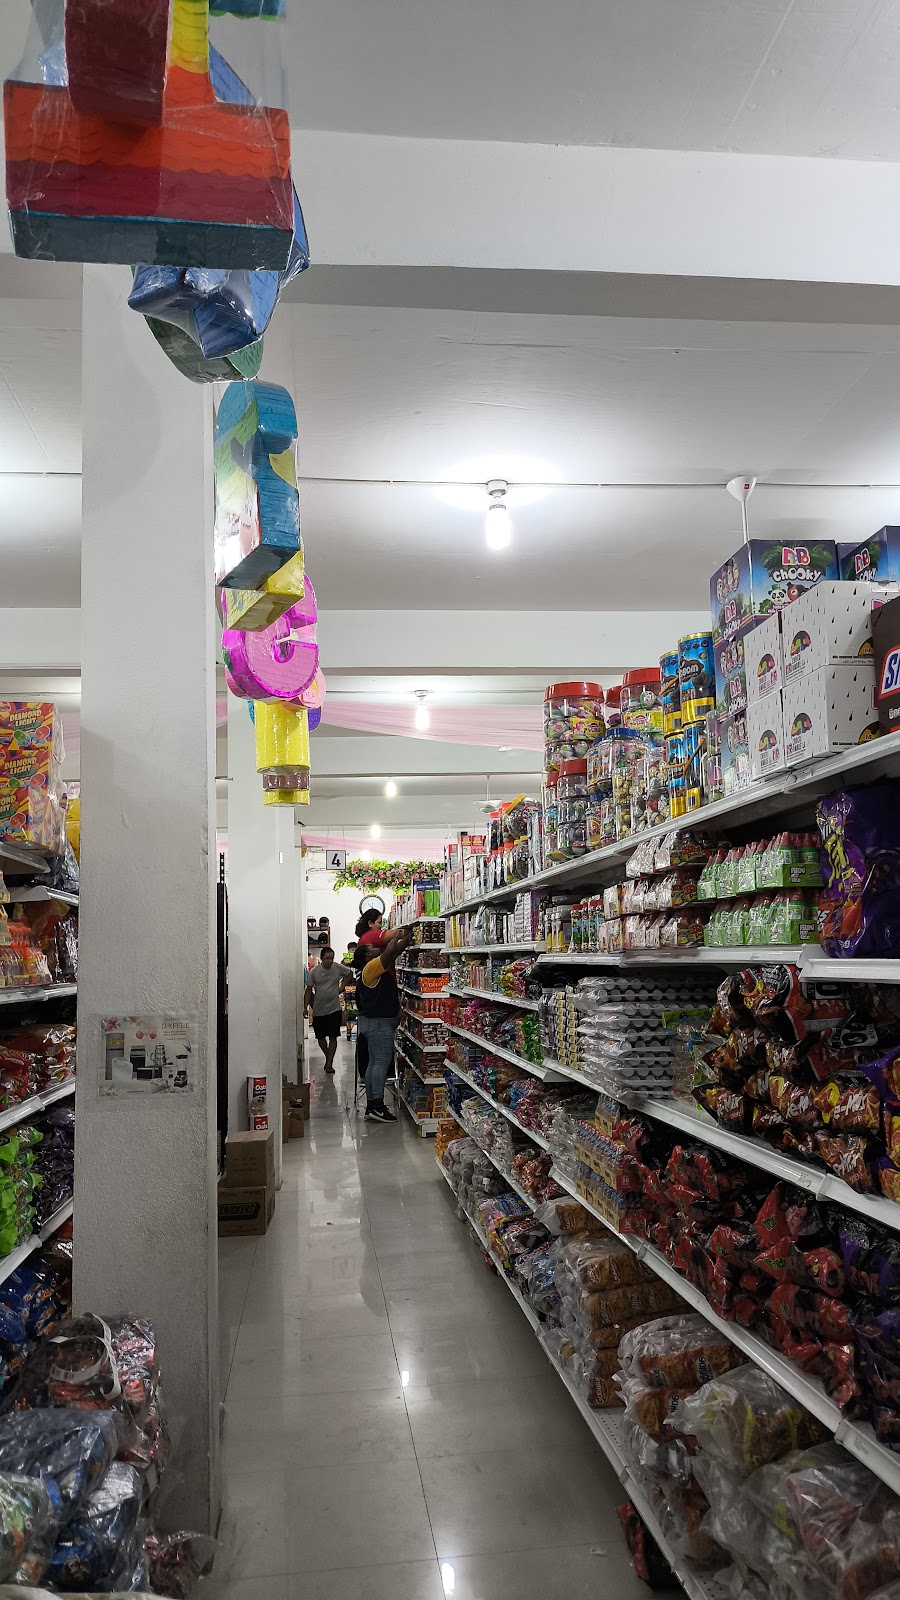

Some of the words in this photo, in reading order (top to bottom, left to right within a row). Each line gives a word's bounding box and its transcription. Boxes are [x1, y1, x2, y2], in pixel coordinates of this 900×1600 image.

[10, 709, 42, 722] DIAMOND
[15, 717, 37, 727] LIGHT
[4, 756, 37, 770] DIAMOND
[10, 765, 32, 775] LIGHT
[331, 853, 341, 867] 4
[219, 1204, 257, 1216] SNICKERS
